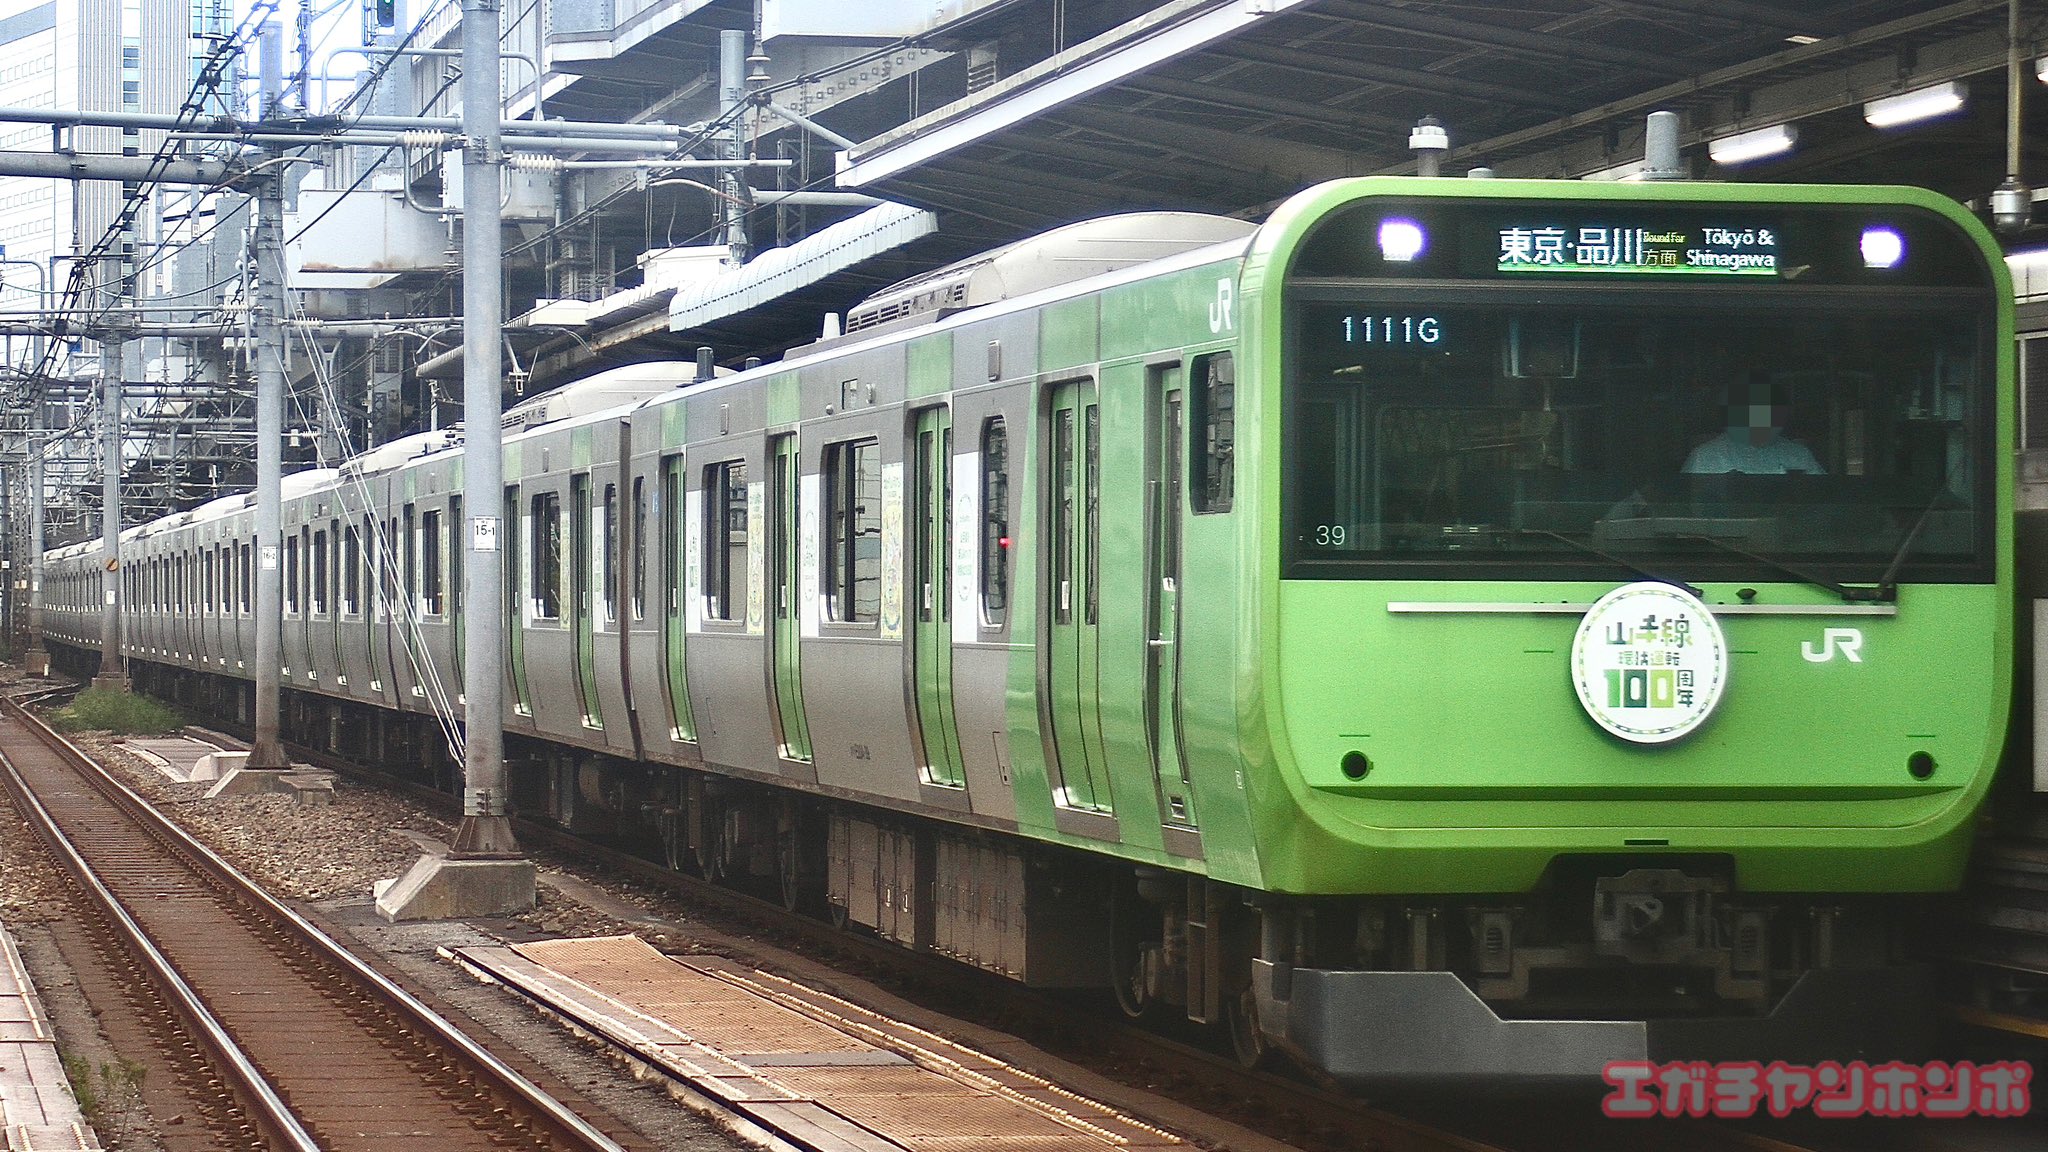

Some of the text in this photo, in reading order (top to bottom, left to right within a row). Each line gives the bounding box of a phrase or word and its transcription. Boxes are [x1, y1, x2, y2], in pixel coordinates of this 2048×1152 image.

[1499, 227, 1642, 265] 東京・品川
[1702, 228, 1775, 249] Tōkyō &
[1642, 249, 1678, 267] 方面
[1686, 249, 1776, 271] Shinagawa
[1209, 277, 1232, 334] JR
[1342, 316, 1440, 343] 1111G
[476, 525, 495, 536] 15-1
[1316, 525, 1345, 546] 39
[1605, 613, 1694, 649] 山手線
[1801, 627, 1863, 663] JR
